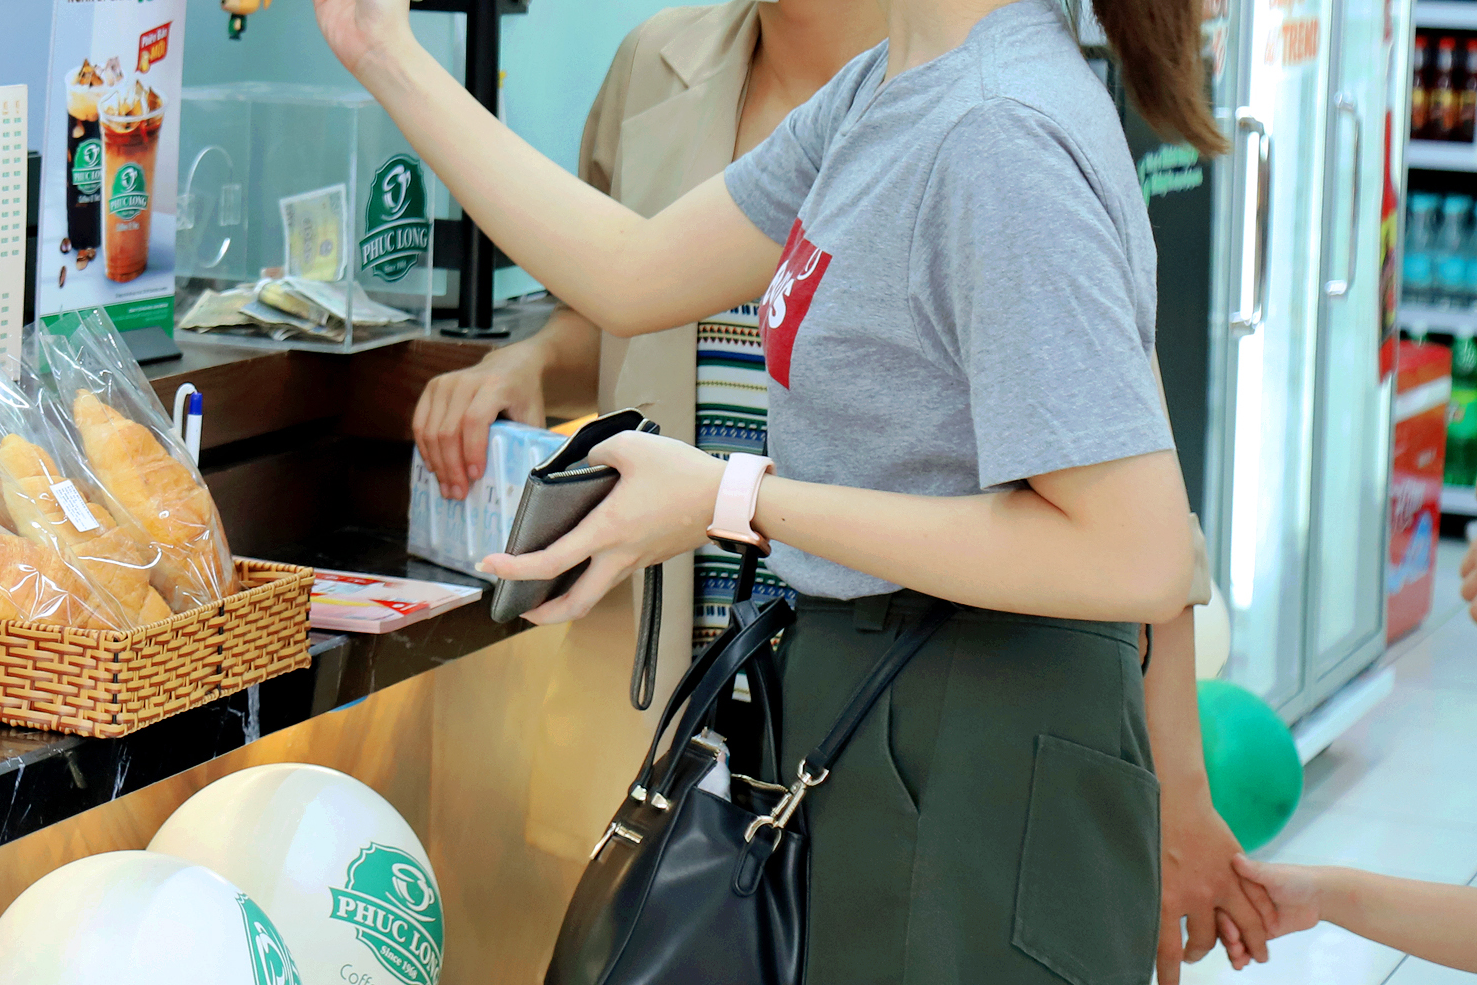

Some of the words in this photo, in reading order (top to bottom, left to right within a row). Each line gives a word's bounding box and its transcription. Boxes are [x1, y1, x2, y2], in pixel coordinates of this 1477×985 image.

[362, 230, 395, 266] PHUC
[396, 227, 428, 250] LONG
[336, 895, 408, 943] PHUC
[380, 945, 403, 967] Since
